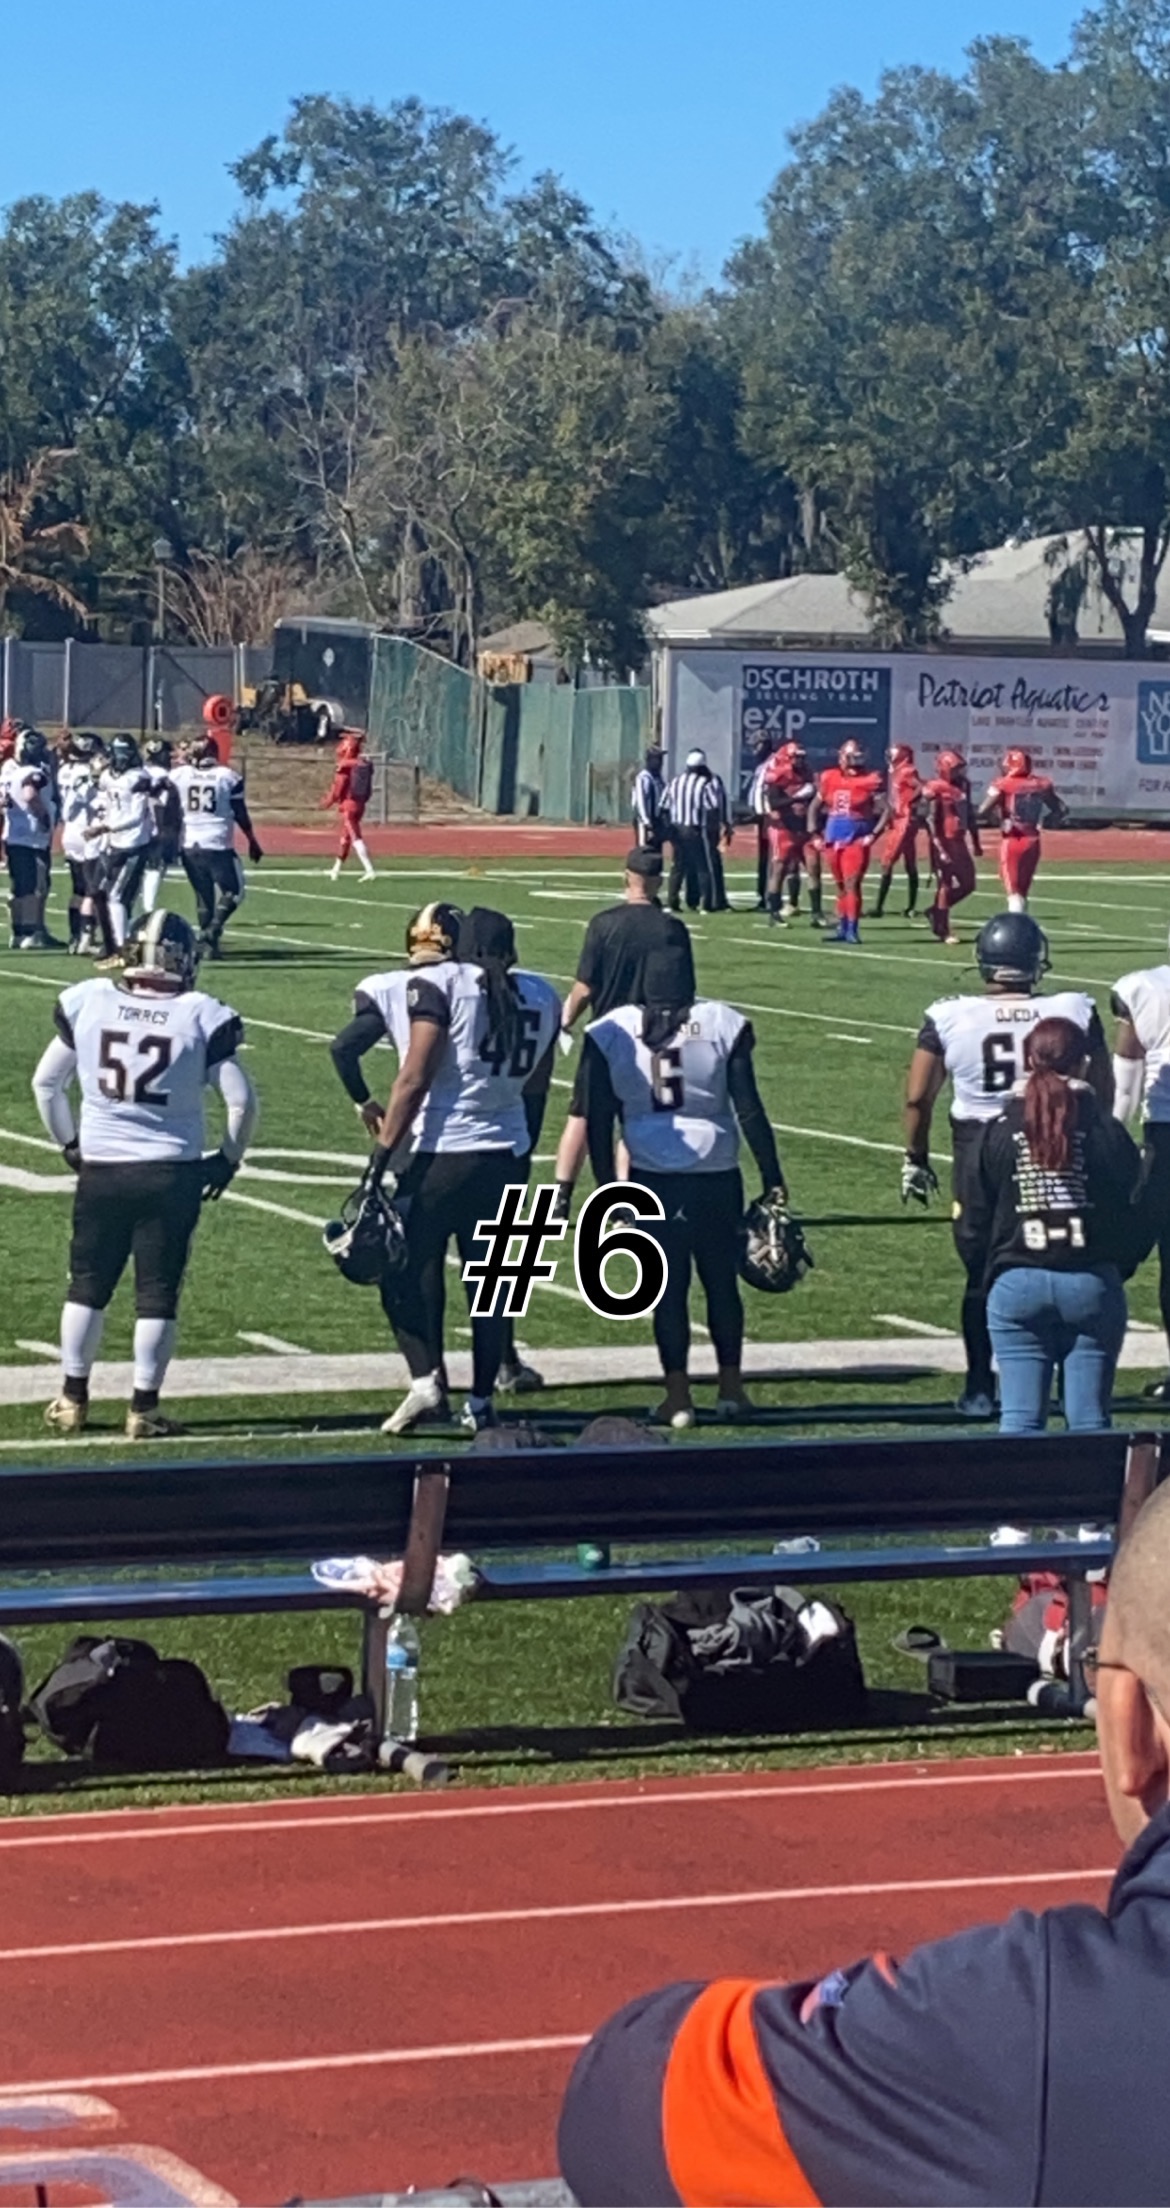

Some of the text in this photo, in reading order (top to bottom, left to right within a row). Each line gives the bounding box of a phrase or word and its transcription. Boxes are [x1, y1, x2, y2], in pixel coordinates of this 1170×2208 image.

[745, 668, 879, 691] DSCHROTH
[919, 672, 1110, 716] Patriot Aquatics
[743, 705, 806, 739] exp
[188, 785, 217, 813] 63
[117, 1005, 169, 1026] TORRES
[479, 1009, 541, 1077] 46
[98, 1028, 171, 1105] 52
[649, 1047, 685, 1112] 6
